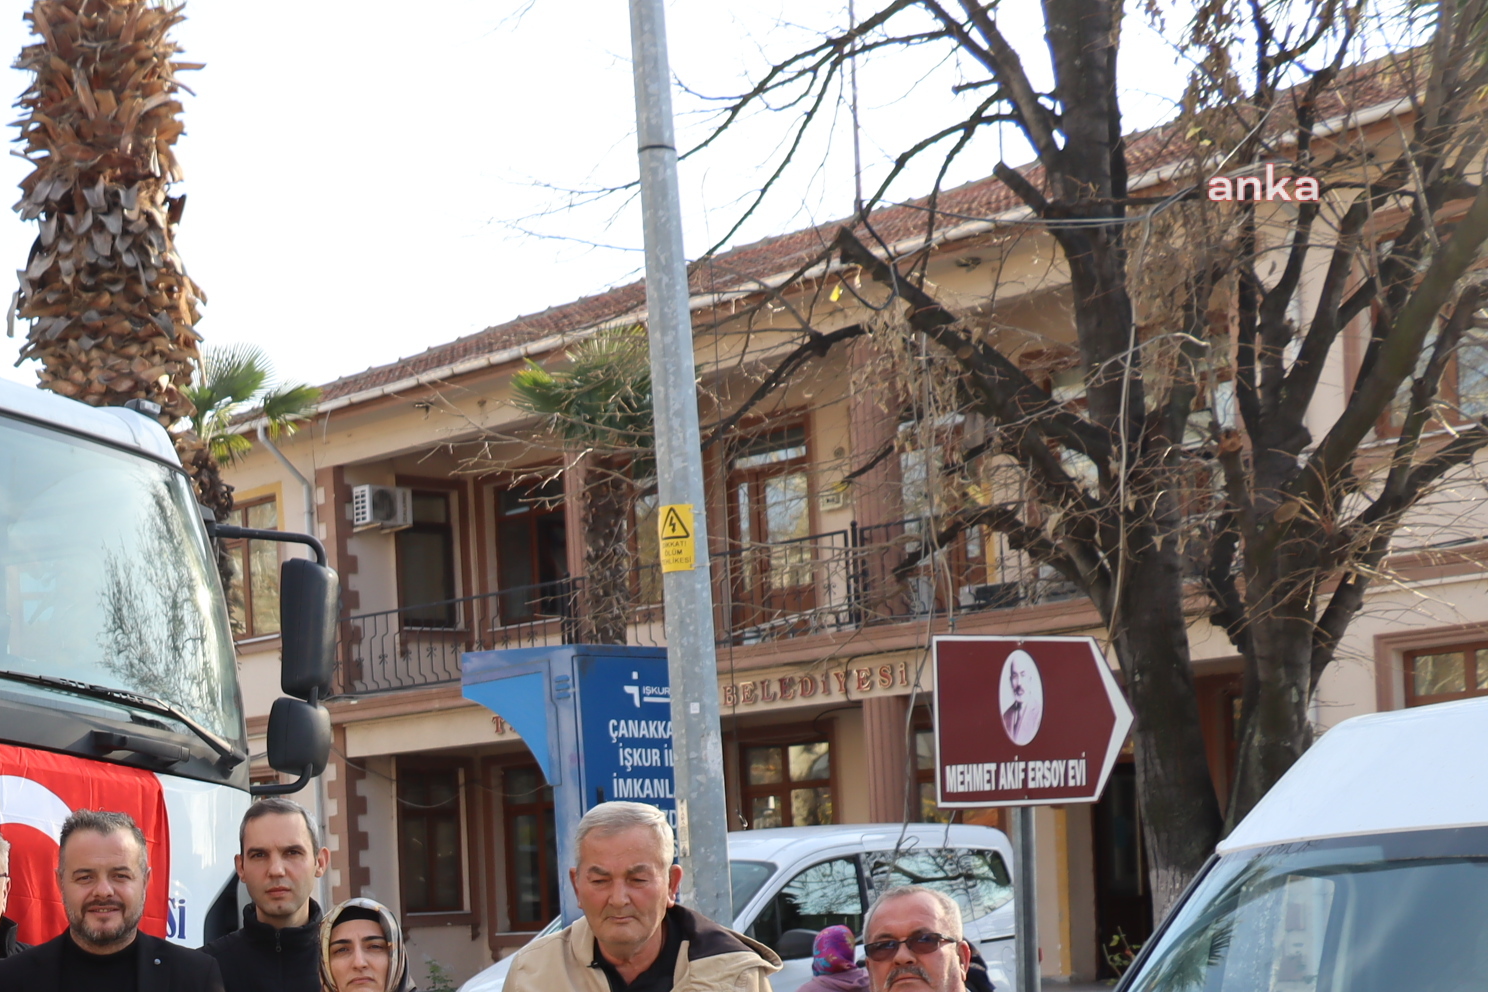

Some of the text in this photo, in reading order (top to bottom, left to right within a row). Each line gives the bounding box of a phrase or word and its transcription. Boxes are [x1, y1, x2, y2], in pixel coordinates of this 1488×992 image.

[722, 661, 908, 706] BELEDİYESİ
[608, 719, 673, 743] ÇANAKKA
[619, 742, 661, 772] İŞKUR
[945, 751, 1087, 793] MEHMET AKİF ERSOY EVİ
[613, 772, 676, 799] İMKANL
